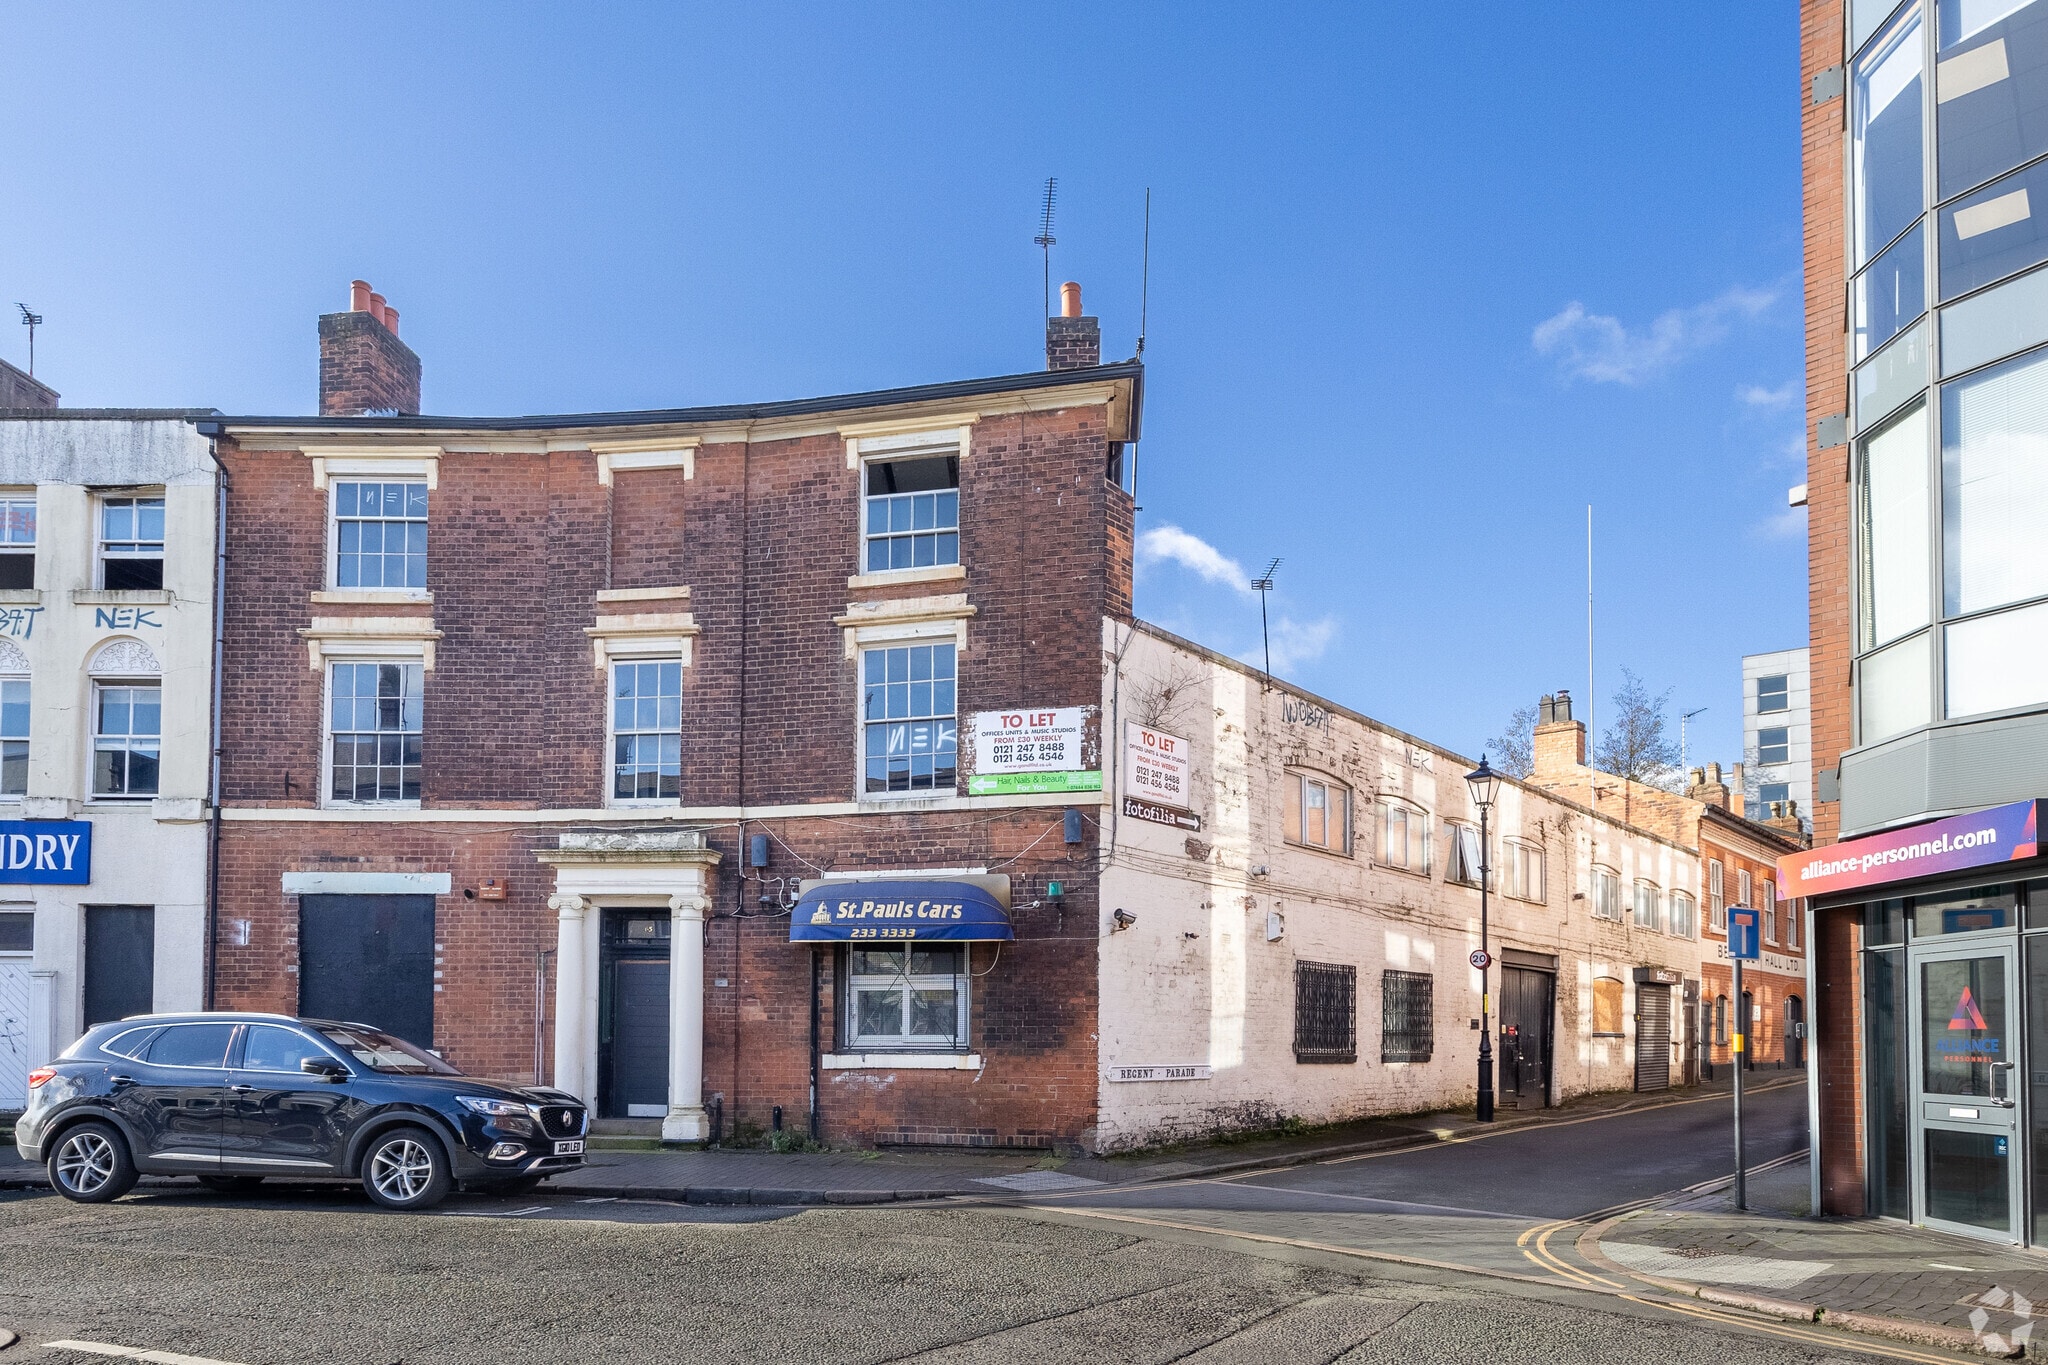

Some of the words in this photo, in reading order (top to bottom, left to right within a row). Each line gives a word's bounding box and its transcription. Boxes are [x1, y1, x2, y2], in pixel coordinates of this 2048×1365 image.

[95, 607, 163, 630] NEK
[1001, 714, 1023, 729] TO
[1029, 712, 1056, 727] LET
[1033, 734, 1063, 742] WEEKLY
[1051, 726, 1077, 734] STUDIOS
[993, 745, 1013, 754] 0121
[1017, 744, 1035, 753] 247
[1039, 743, 1065, 752] 8488
[1141, 731, 1155, 747] TO
[1159, 737, 1175, 753] LET
[993, 754, 1013, 763] 0121
[1016, 753, 1035, 762] 456
[1039, 752, 1064, 761] 4546
[1014, 776, 1031, 784] Nails
[1033, 775, 1039, 783] &
[1041, 774, 1067, 784] Beauty
[1136, 765, 1150, 776] 0121
[1151, 770, 1163, 780] 247
[1164, 773, 1180, 785] 8488
[1136, 775, 1149, 785] 0121
[1150, 779, 1163, 789] 456
[1164, 783, 1180, 793] 4546
[1125, 800, 1176, 825] fotofilia
[0, 833, 81, 871] DRY
[1800, 827, 1997, 881] alliance-personnel.com
[917, 900, 963, 919] Cars
[850, 928, 878, 938] 233
[880, 928, 917, 938] 3333
[1472, 954, 1486, 963] 20
[1764, 953, 1782, 970] HALL
[1935, 1038, 2000, 1053] ALLIANCE
[1943, 1055, 1993, 1063] PERSONNEL
[1120, 1069, 1154, 1079] REGENT
[1166, 1068, 1196, 1078] PARADE
